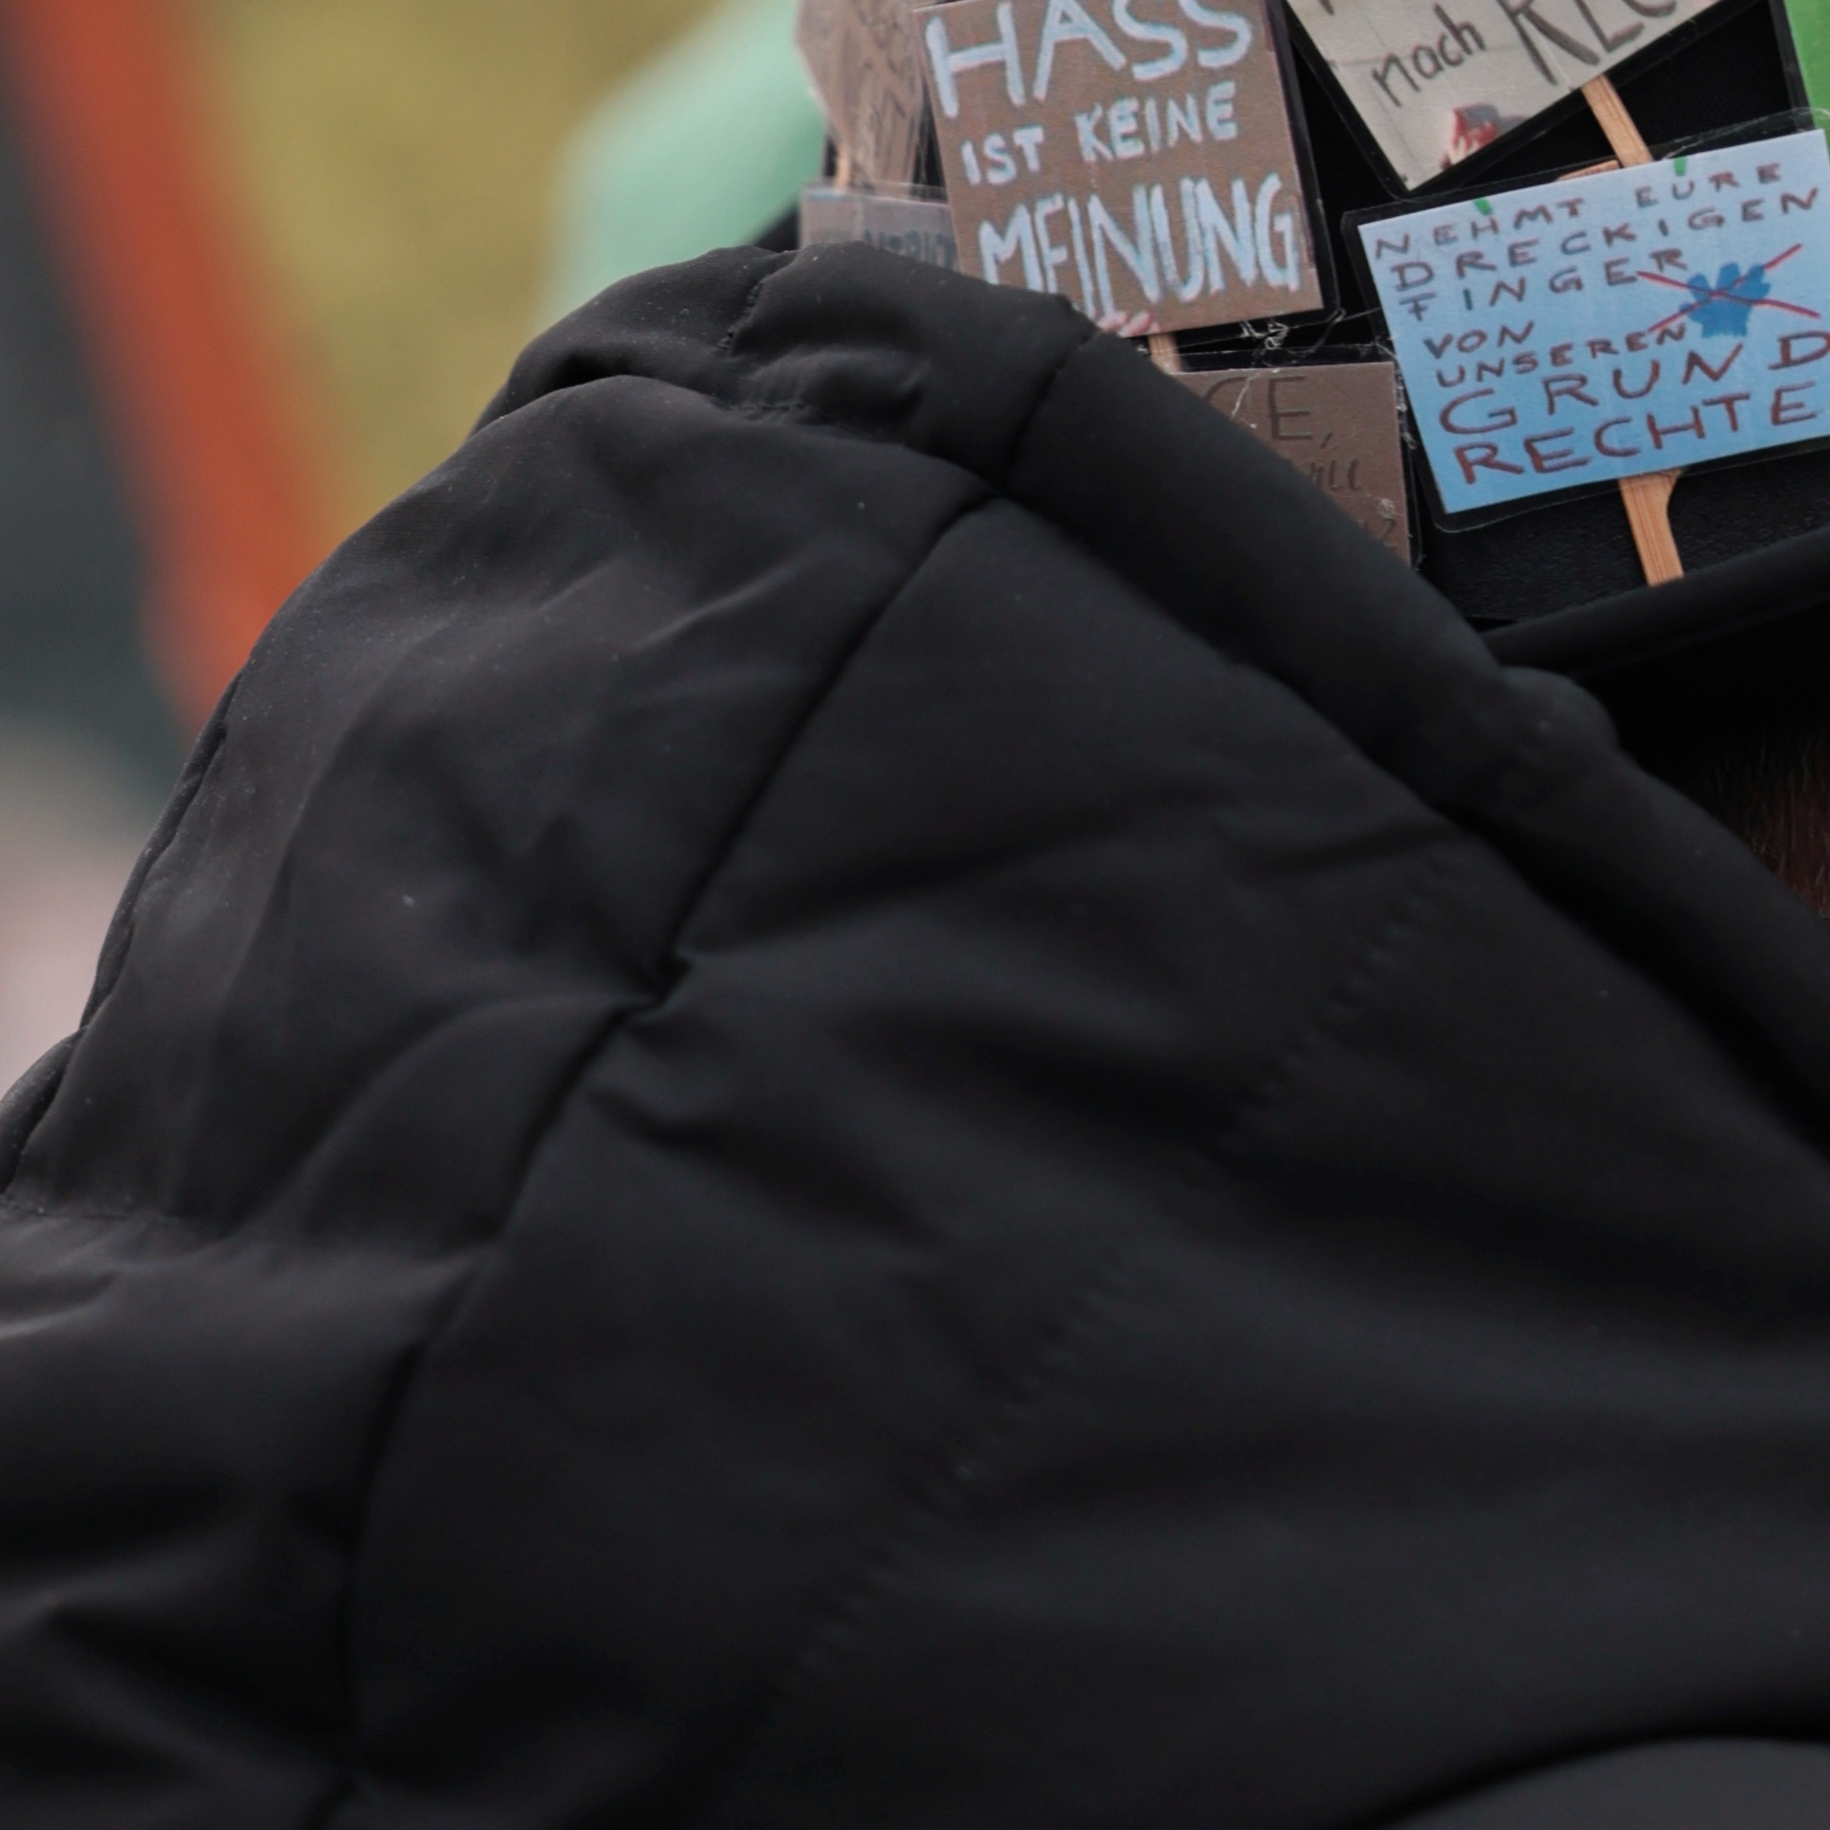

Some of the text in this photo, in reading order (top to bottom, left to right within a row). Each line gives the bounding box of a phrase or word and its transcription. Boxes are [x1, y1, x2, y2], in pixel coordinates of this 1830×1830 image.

[1372, 2, 1486, 107] nach
[962, 80, 1239, 185] IST KEINE
[977, 171, 1301, 321] MEINUNG
[1375, 163, 1782, 260] NEHMT EURE
[1389, 186, 1818, 292] DRECKIGEN
[1400, 247, 1689, 322] FINGER
[1423, 321, 1535, 359] VON
[1436, 323, 1686, 389] UNSEREN
